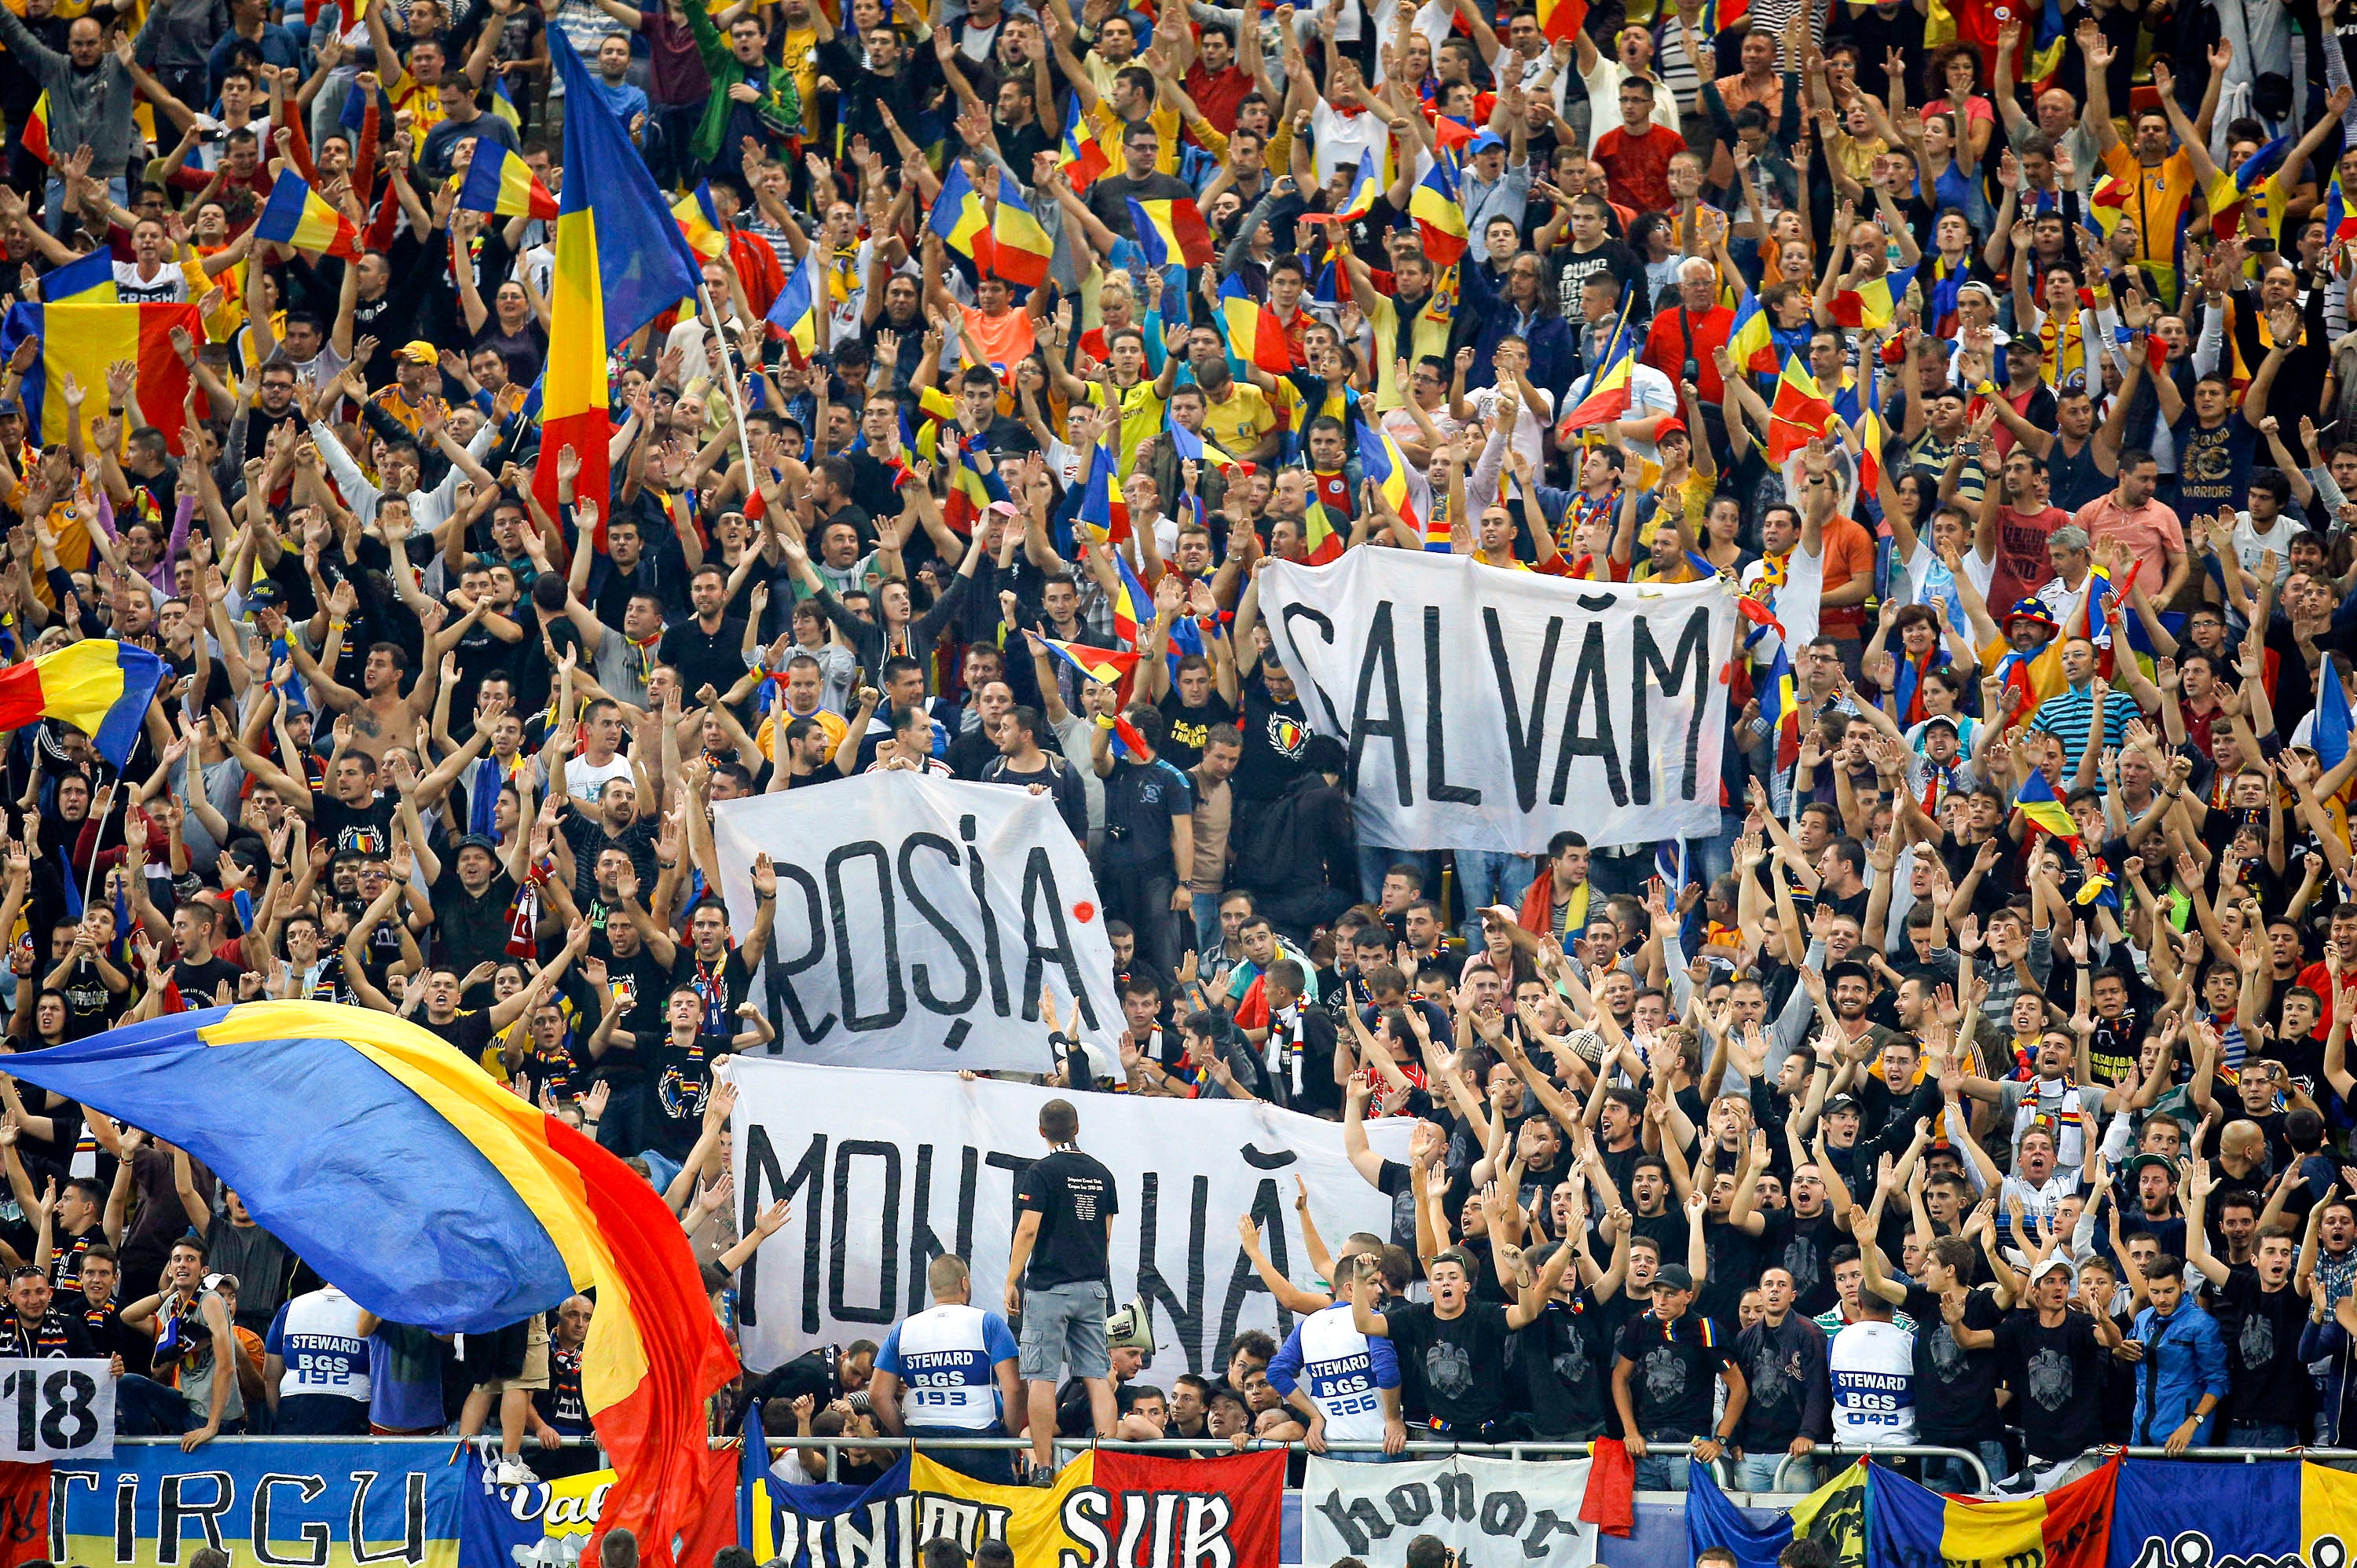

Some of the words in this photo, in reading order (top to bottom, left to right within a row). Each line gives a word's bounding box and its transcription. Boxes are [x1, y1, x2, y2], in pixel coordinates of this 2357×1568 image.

[119, 293, 174, 302] CRASH
[2189, 427, 2230, 445] COORADO
[1283, 592, 1709, 813] SALVĂM
[740, 1124, 1297, 1374] MONTNĂ
[291, 1335, 361, 1354] STEWARD
[298, 1354, 350, 1372] BGS
[906, 1351, 974, 1370] STEWARD
[1310, 1354, 1369, 1379] STEWARD
[297, 1369, 350, 1385] 192
[914, 1370, 966, 1387] BGS
[1321, 1375, 1369, 1397] BGS
[1838, 1372, 1907, 1391] STEWARD
[915, 1390, 967, 1406] 193
[1326, 1394, 1378, 1416] 226
[1846, 1392, 1897, 1412] BGS
[2, 1369, 99, 1452] 18
[49, 1468, 428, 1568] TÎRGU
[1314, 1471, 1580, 1559] honor
